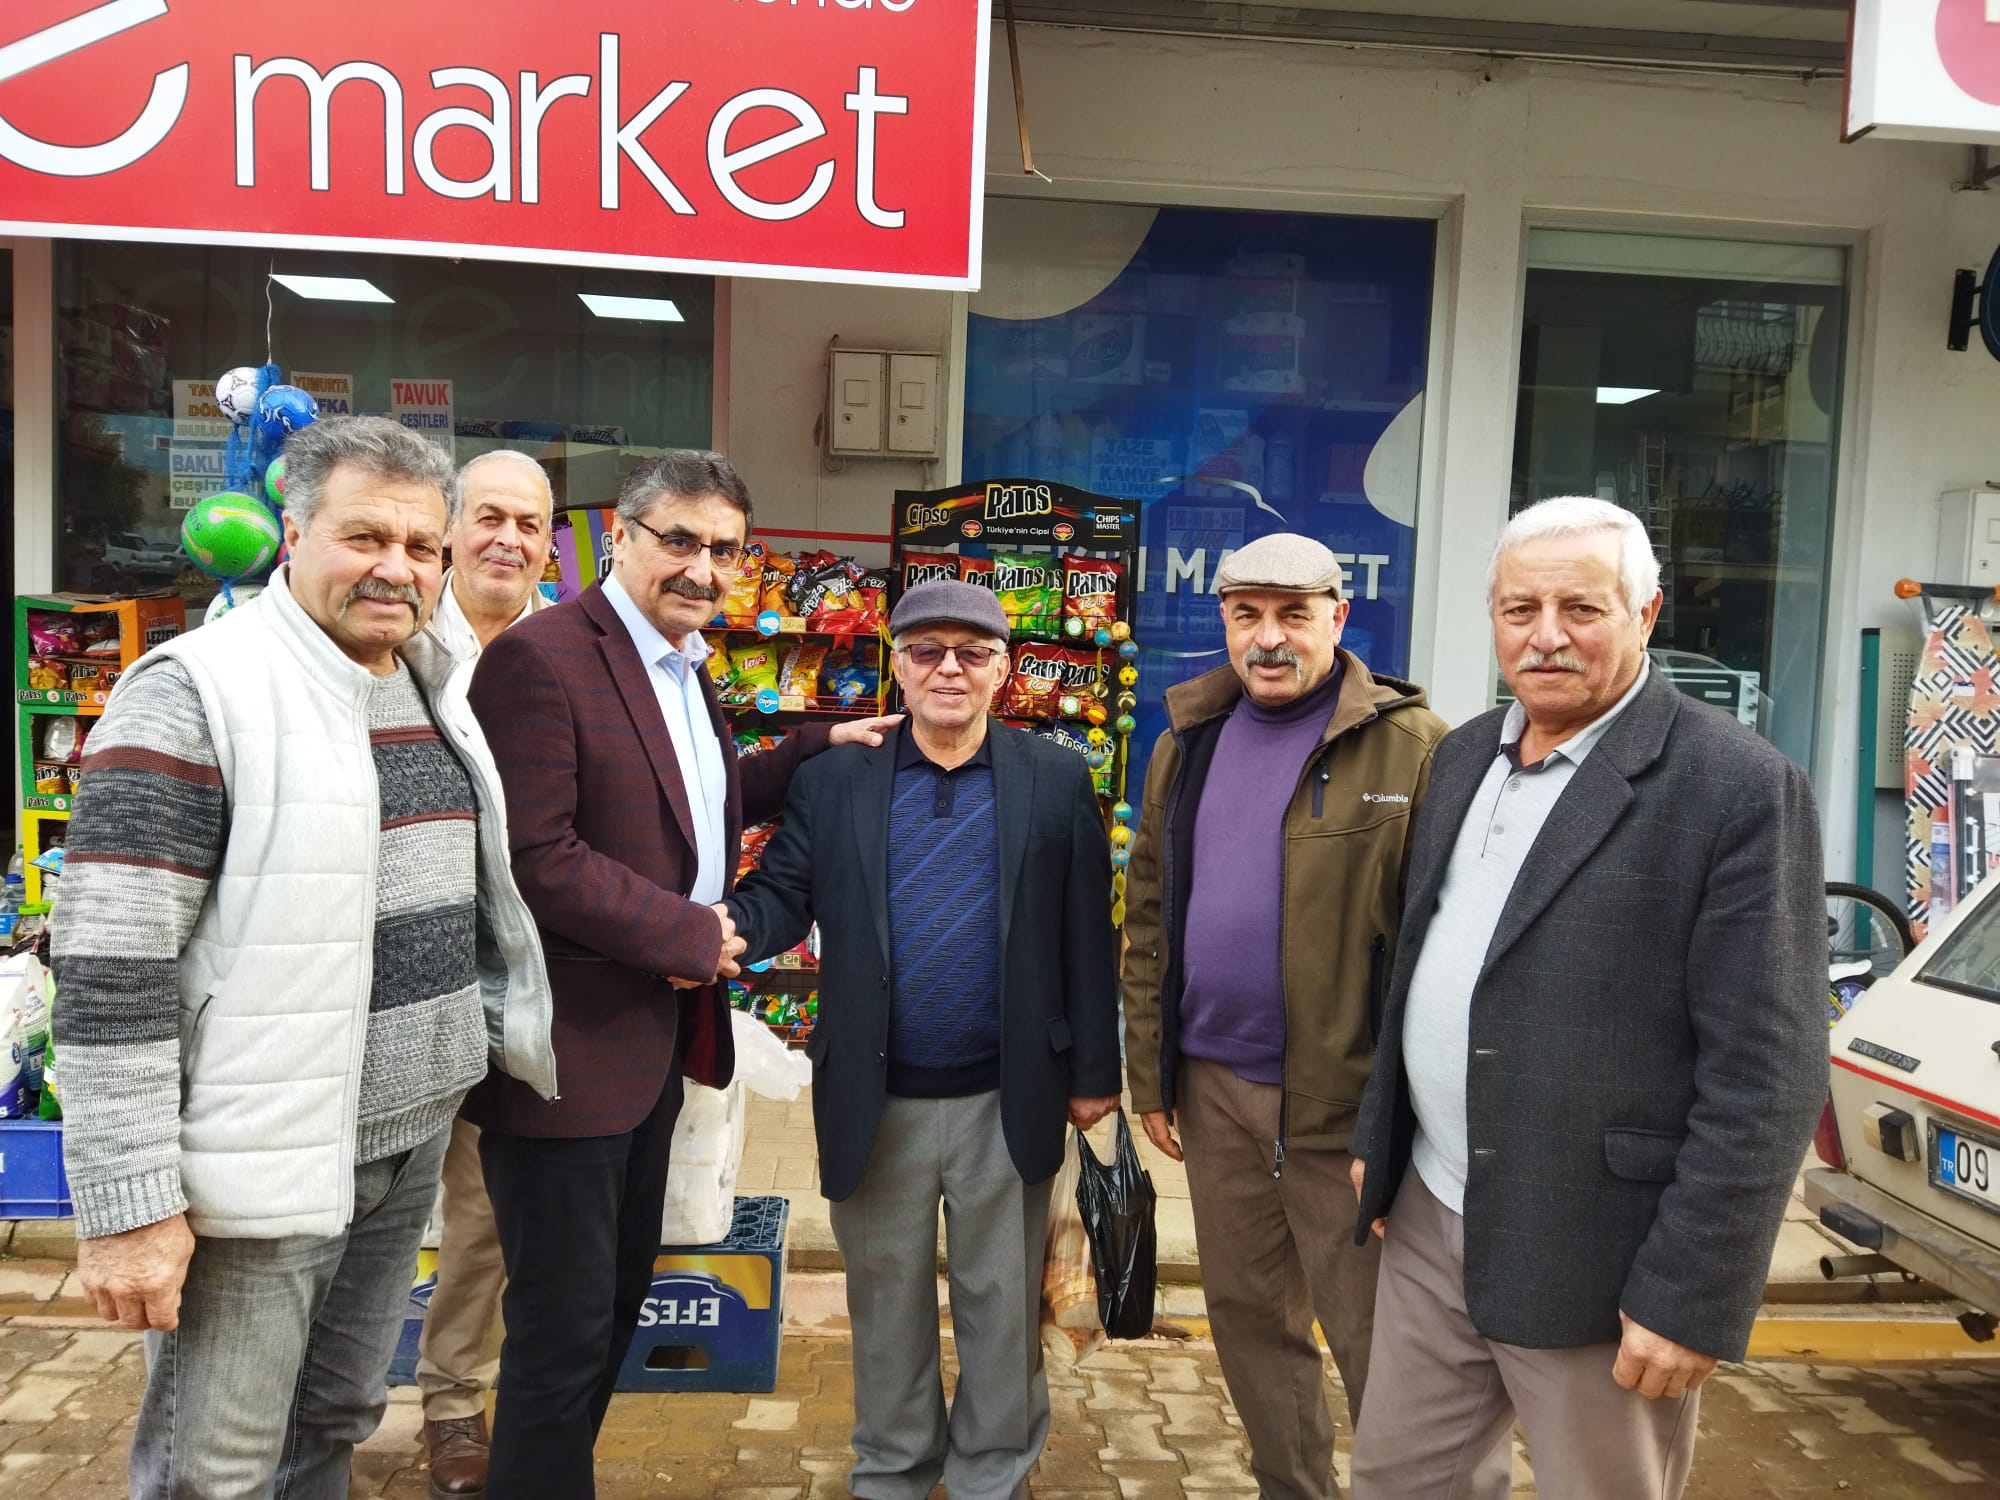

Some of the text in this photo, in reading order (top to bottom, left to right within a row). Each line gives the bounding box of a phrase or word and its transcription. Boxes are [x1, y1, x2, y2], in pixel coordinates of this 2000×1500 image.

[233, 33, 909, 229] market
[187, 383, 217, 398] TAV
[392, 383, 449, 406] TAVUK
[187, 402, 225, 418] DÖN
[172, 451, 226, 474] BAKLİ
[1095, 514, 1120, 523] CHIPS
[986, 525, 1050, 536] Türkiye'nin Cipsi
[1371, 793, 1409, 803] Columbia
[1941, 1141, 1990, 1192] TR 09
[637, 1297, 721, 1327] EFES
